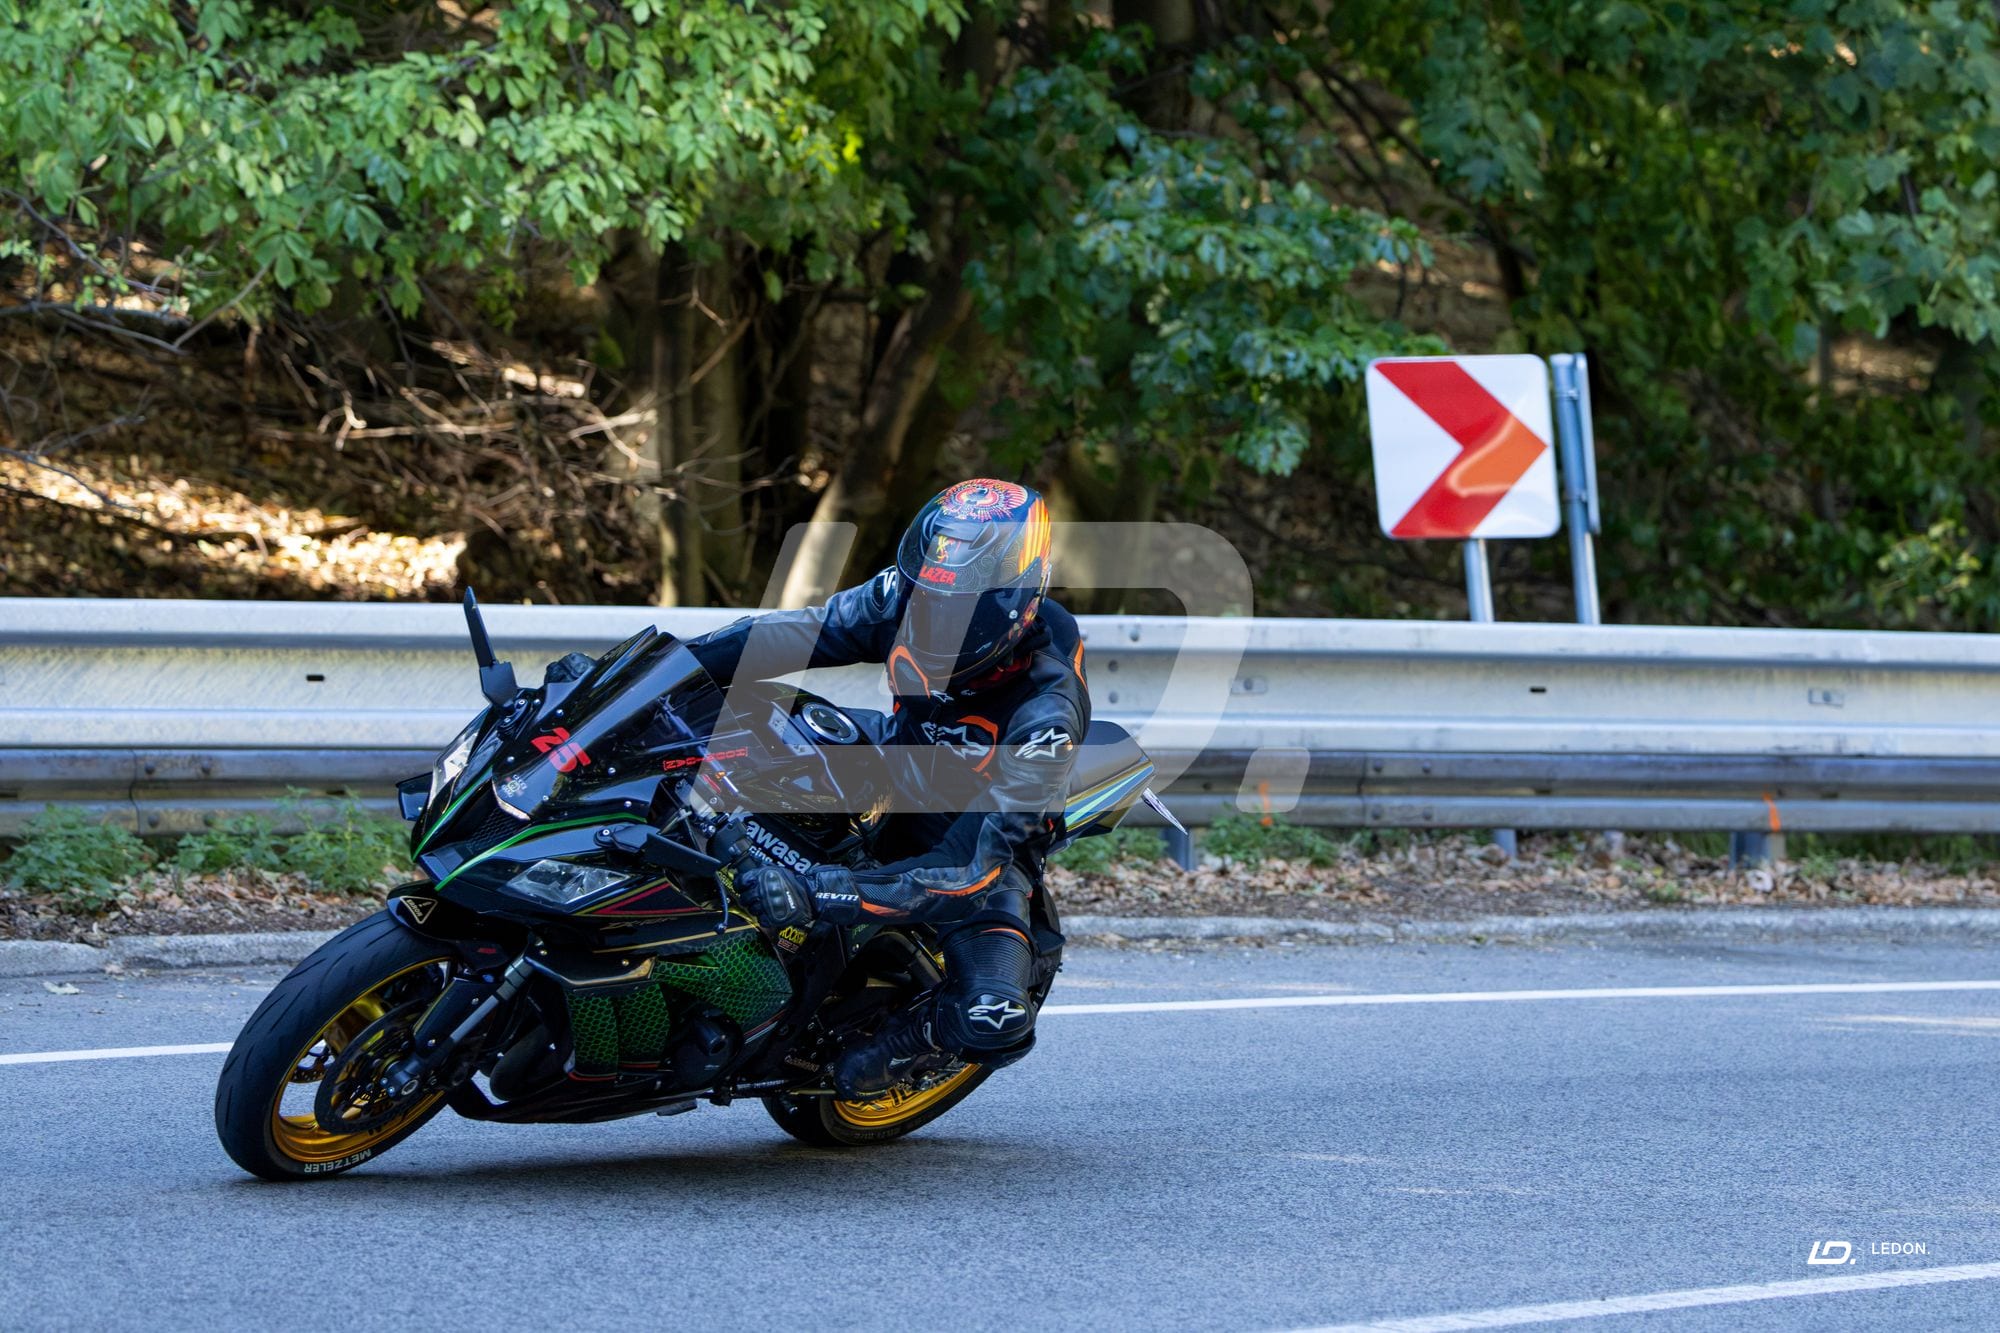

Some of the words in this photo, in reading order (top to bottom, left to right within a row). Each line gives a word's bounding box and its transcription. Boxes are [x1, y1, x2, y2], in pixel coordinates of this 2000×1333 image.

[919, 564, 957, 585] LAZER
[531, 726, 592, 773] 25
[728, 805, 820, 875] Kawasa
[304, 1148, 372, 1173] METZELER
